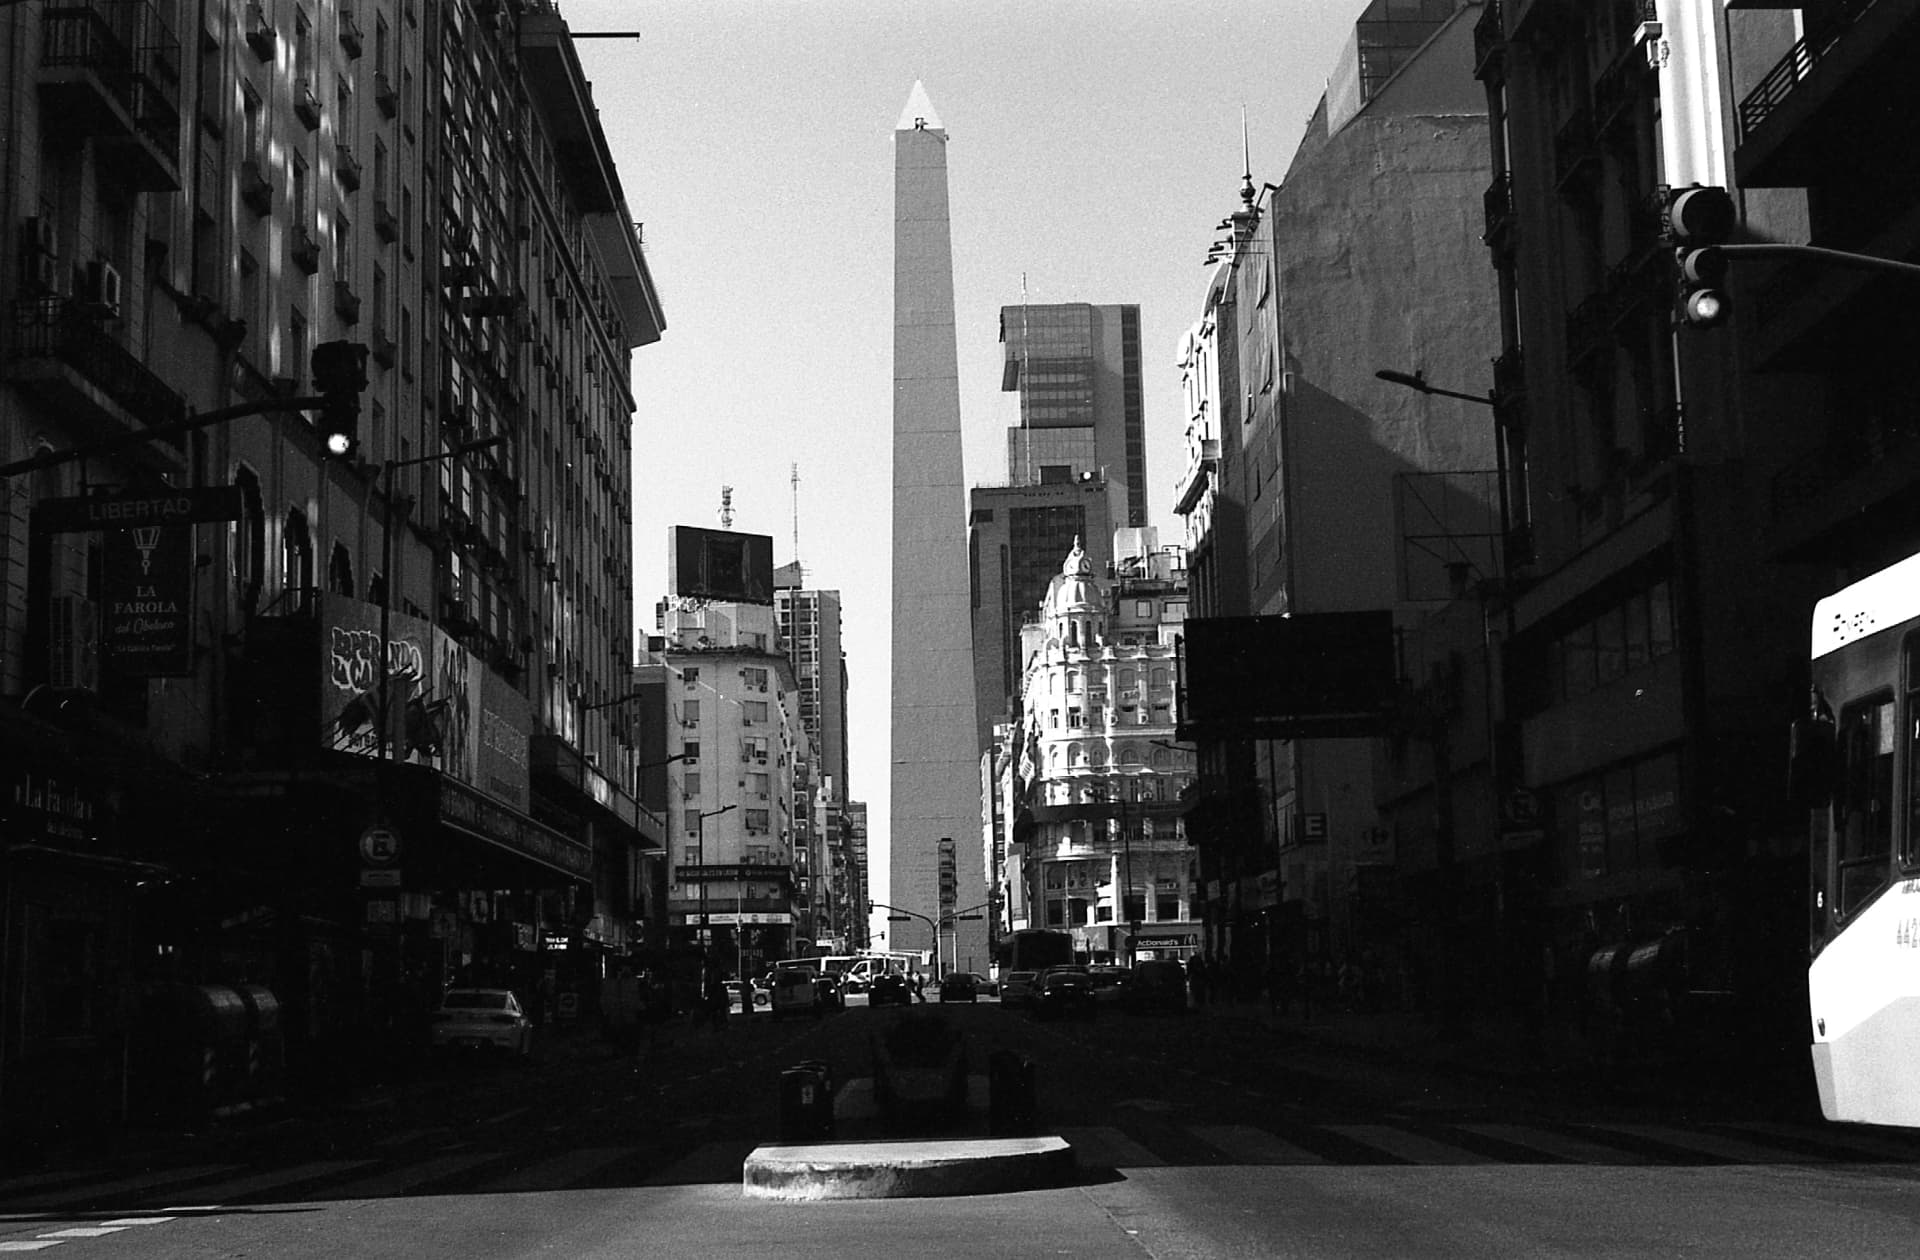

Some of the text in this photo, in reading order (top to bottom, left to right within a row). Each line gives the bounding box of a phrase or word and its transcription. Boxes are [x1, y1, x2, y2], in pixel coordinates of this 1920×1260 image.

[88, 497, 192, 521] LIBERTAD
[136, 585, 157, 597] LA
[114, 601, 178, 614] FAROLA
[1896, 917, 1920, 950] 442
